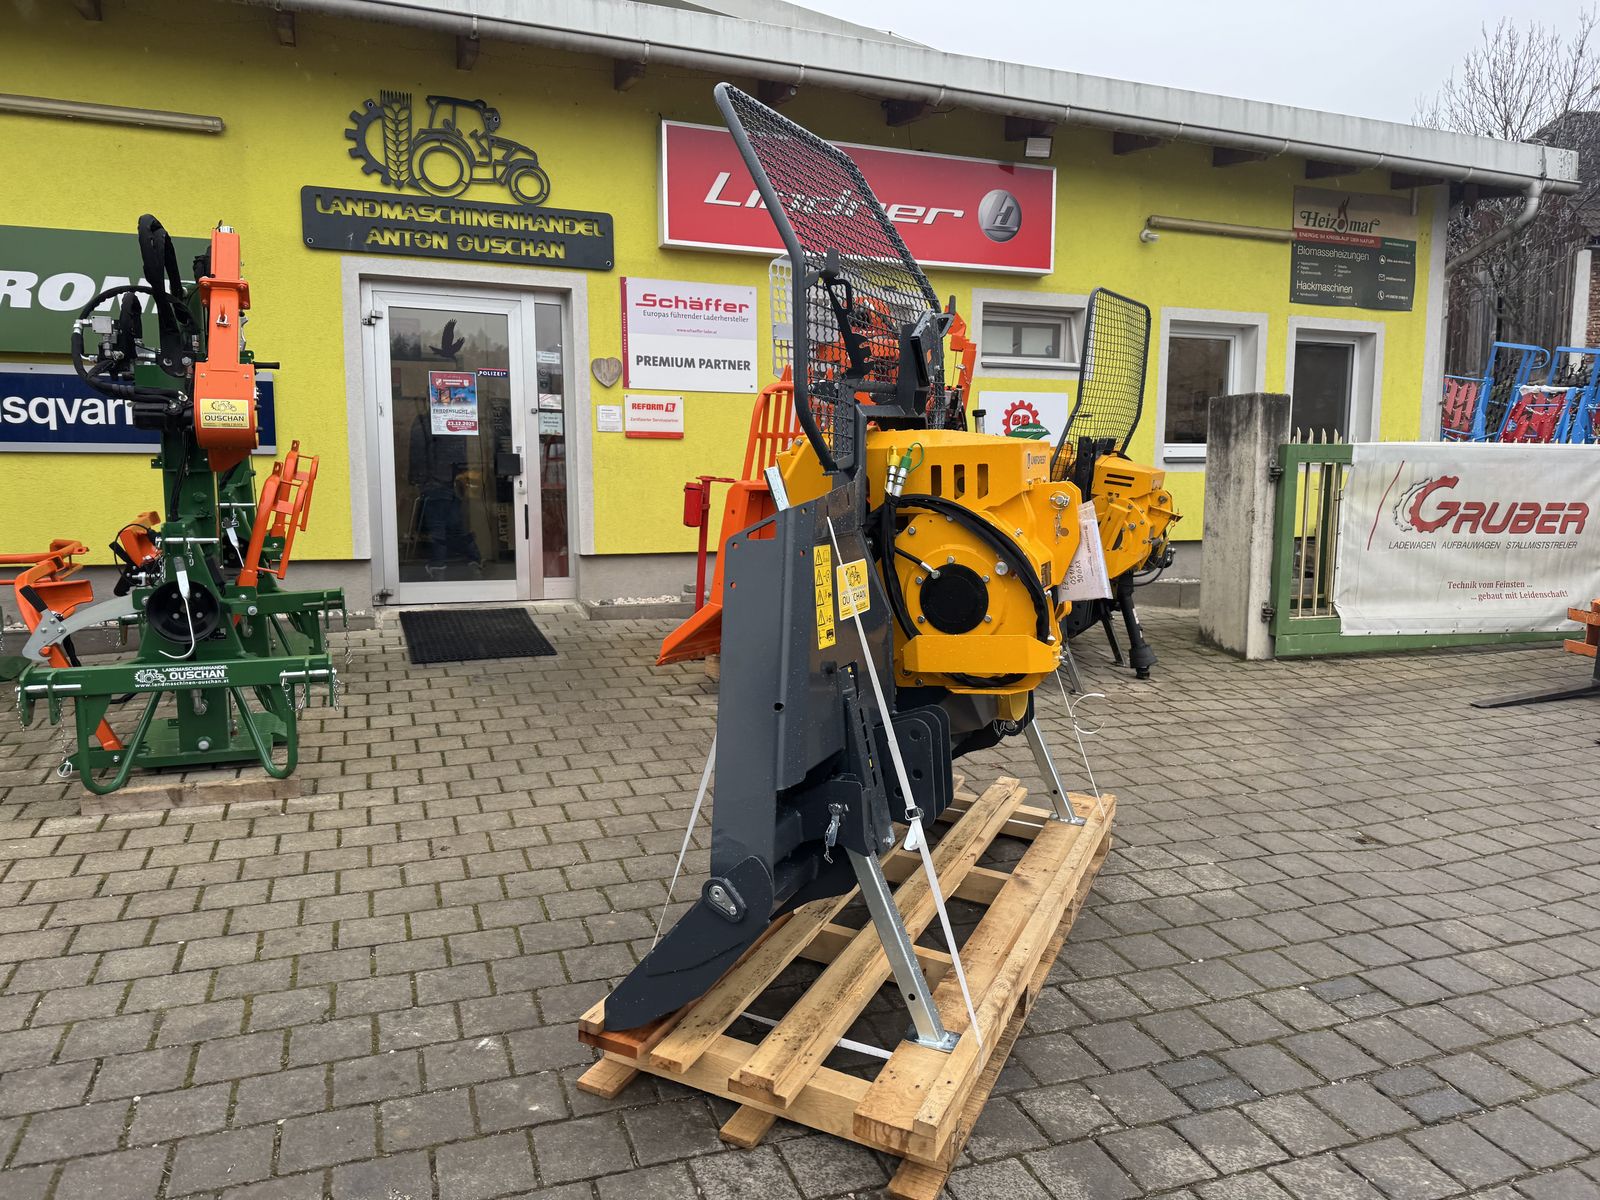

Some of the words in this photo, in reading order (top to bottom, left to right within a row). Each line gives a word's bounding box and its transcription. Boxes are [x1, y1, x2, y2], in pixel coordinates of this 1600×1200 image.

[315, 194, 605, 239] LANDMASCHINENHANDEL
[366, 226, 448, 251] ANTON
[456, 234, 566, 260] OUSCHAN
[1297, 245, 1370, 263] Biomasseheizungen
[1296, 280, 1353, 294] Hackmaschinen
[635, 293, 749, 313] Schäffer
[643, 309, 670, 319] Europas
[670, 311, 702, 320] führender
[703, 314, 749, 323] Laderhersteller
[636, 355, 696, 369] PREMIUM
[698, 358, 751, 371] PARTNER
[631, 402, 664, 411] REFORM
[204, 414, 245, 422] OUSCHAN
[1011, 414, 1031, 426] BB
[1408, 475, 1590, 534] GRUBER
[1388, 541, 1437, 550] LADEWAGEN
[1441, 540, 1502, 550] AUFBAUWAGEN
[1505, 540, 1578, 550] STALLMISTSTREUER
[1447, 581, 1478, 590] Technik
[1495, 580, 1526, 589] Feinsten
[842, 590, 867, 606] OUCHAN
[1477, 592, 1503, 602] gebaut
[1504, 591, 1518, 599] mit
[1519, 589, 1569, 600] Leidenschaft!
[169, 669, 224, 680] OUSCHAN
[135, 679, 229, 688] www.landmaschinen-ouschan.at
